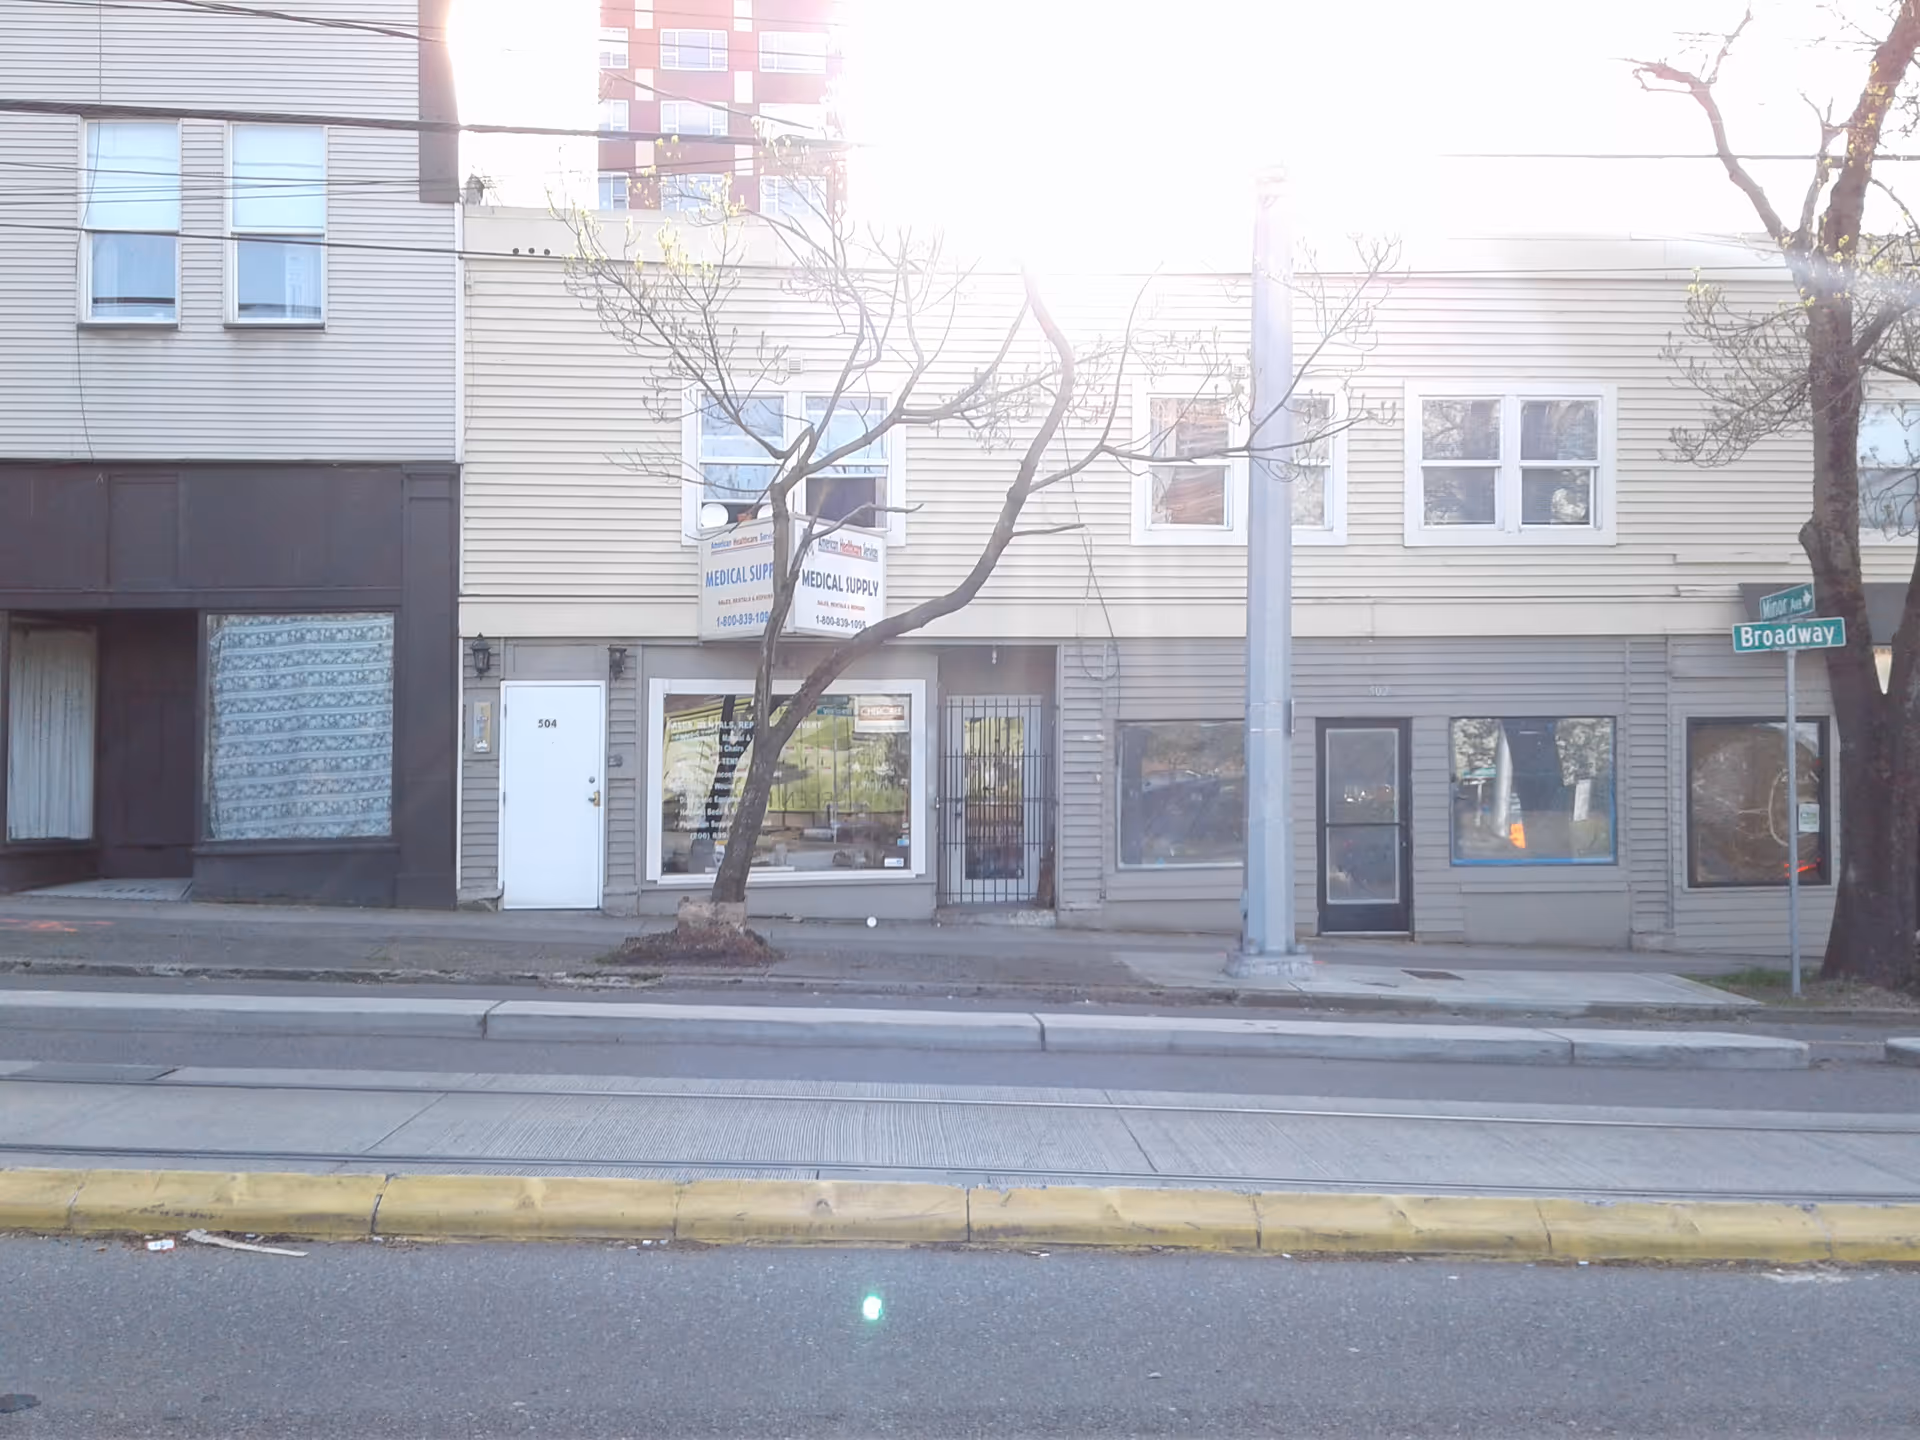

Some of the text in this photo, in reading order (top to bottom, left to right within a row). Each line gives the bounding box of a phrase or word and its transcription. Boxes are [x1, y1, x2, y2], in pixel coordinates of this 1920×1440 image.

[705, 562, 774, 588] MEDICAL SUPP
[802, 568, 879, 597] MEDICAL SUPPLY
[716, 610, 770, 627] 1-800-839-109
[816, 614, 867, 629] 1-800-839-1095
[1741, 625, 1834, 647] Broadway
[538, 718, 557, 728] 504
